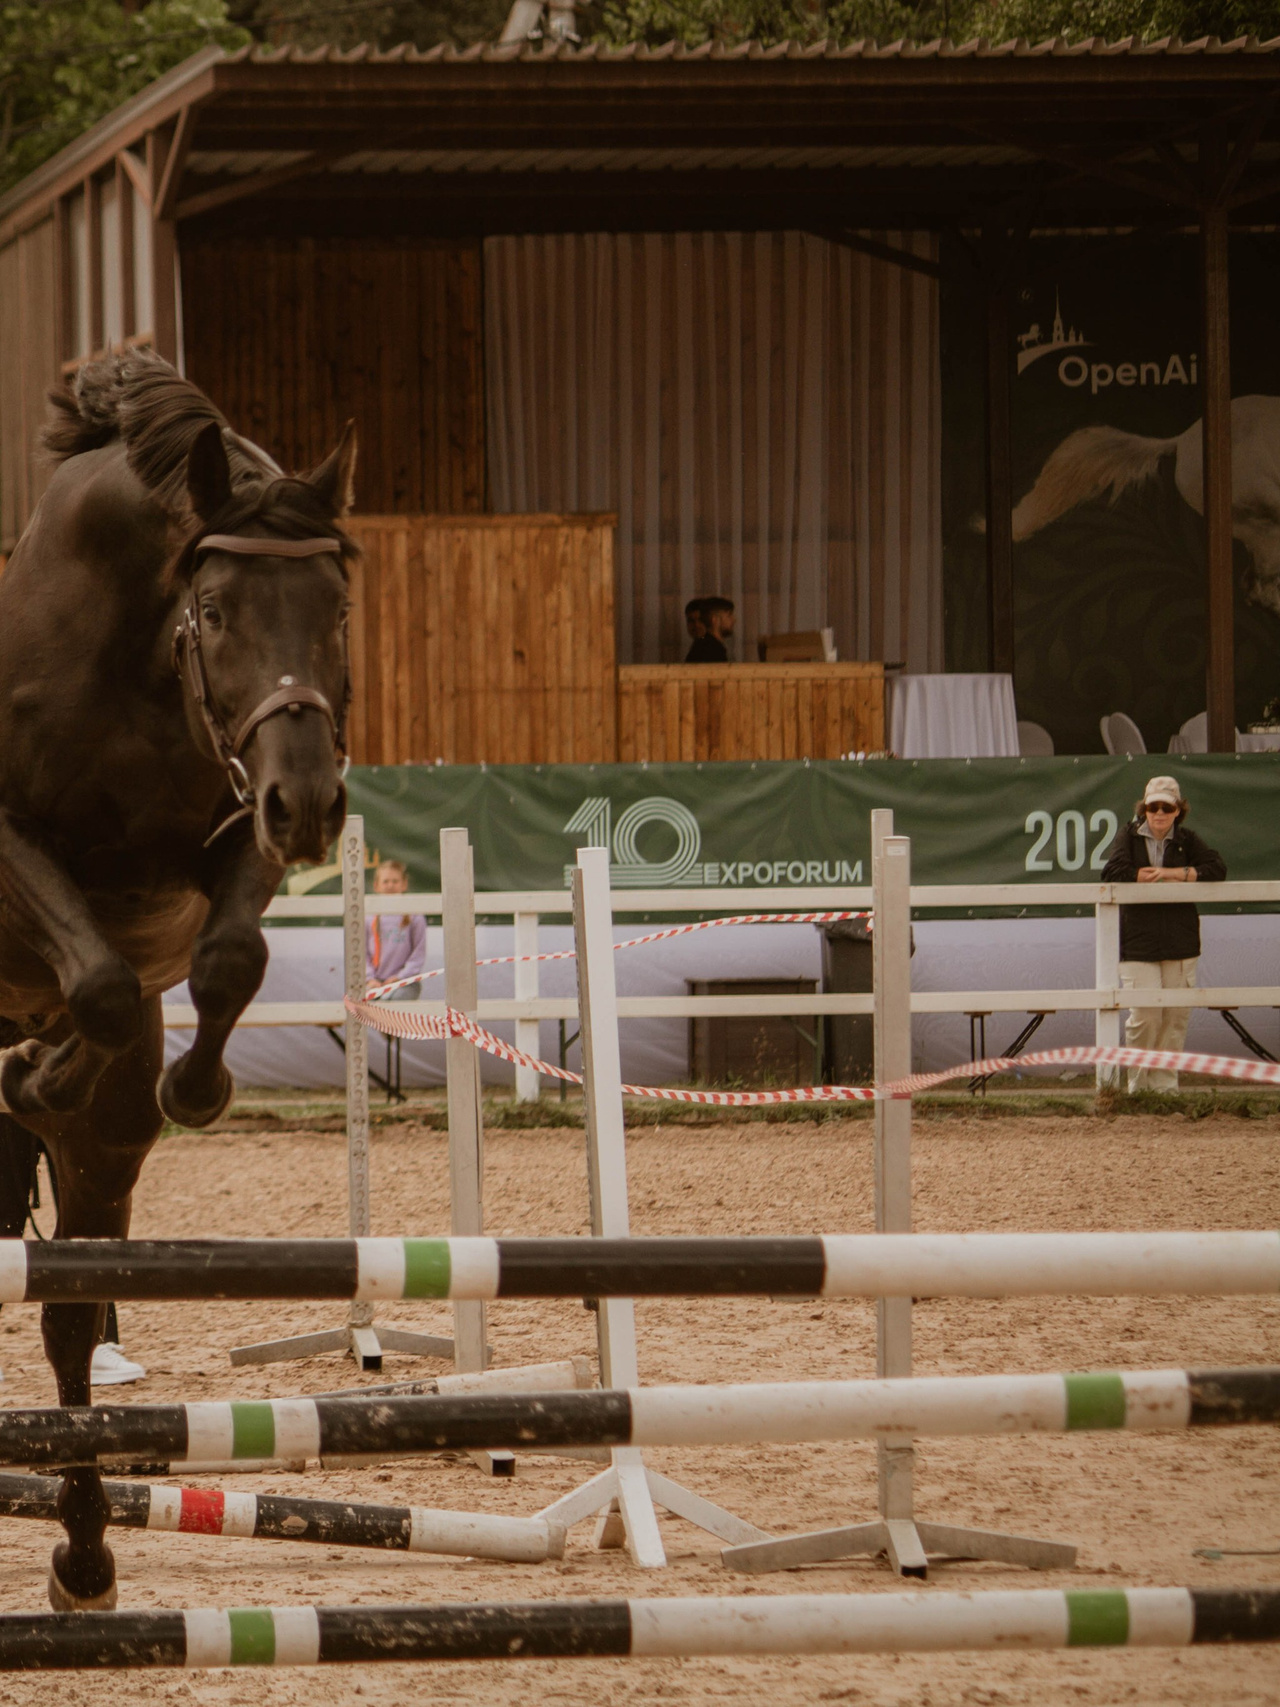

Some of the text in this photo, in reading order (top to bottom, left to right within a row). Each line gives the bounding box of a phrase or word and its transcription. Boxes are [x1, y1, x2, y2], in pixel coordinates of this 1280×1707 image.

[563, 796, 863, 886] 10 EXPOFORUM
[1024, 809, 1140, 872] 202
